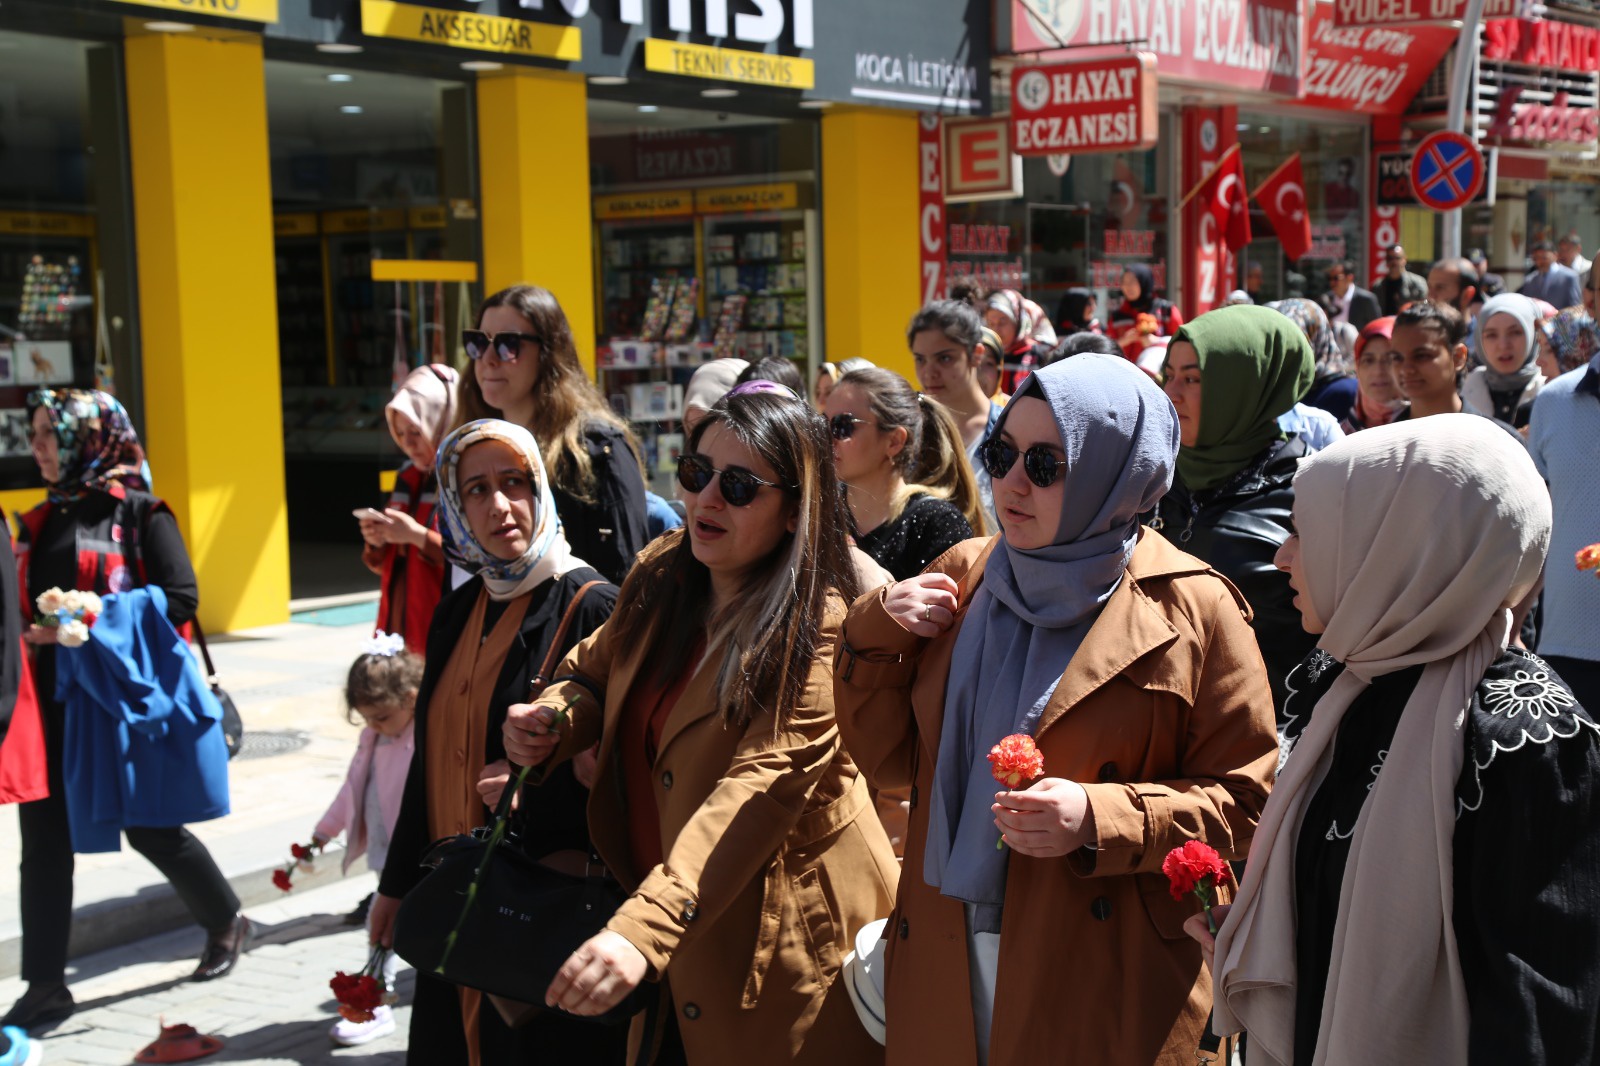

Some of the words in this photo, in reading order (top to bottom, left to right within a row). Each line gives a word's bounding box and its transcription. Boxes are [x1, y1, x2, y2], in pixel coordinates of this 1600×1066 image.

[419, 12, 533, 50] AKSESUAR
[671, 47, 733, 78] TEKNİK
[738, 55, 793, 84] SERVİS
[855, 52, 904, 83] KOCA
[907, 53, 977, 97] İLETİŞİM
[1053, 68, 1137, 104] HAYAT
[1016, 105, 1137, 149] ECZANESİ
[950, 224, 1011, 254] HAYAT
[1104, 230, 1156, 256] HAYAT
